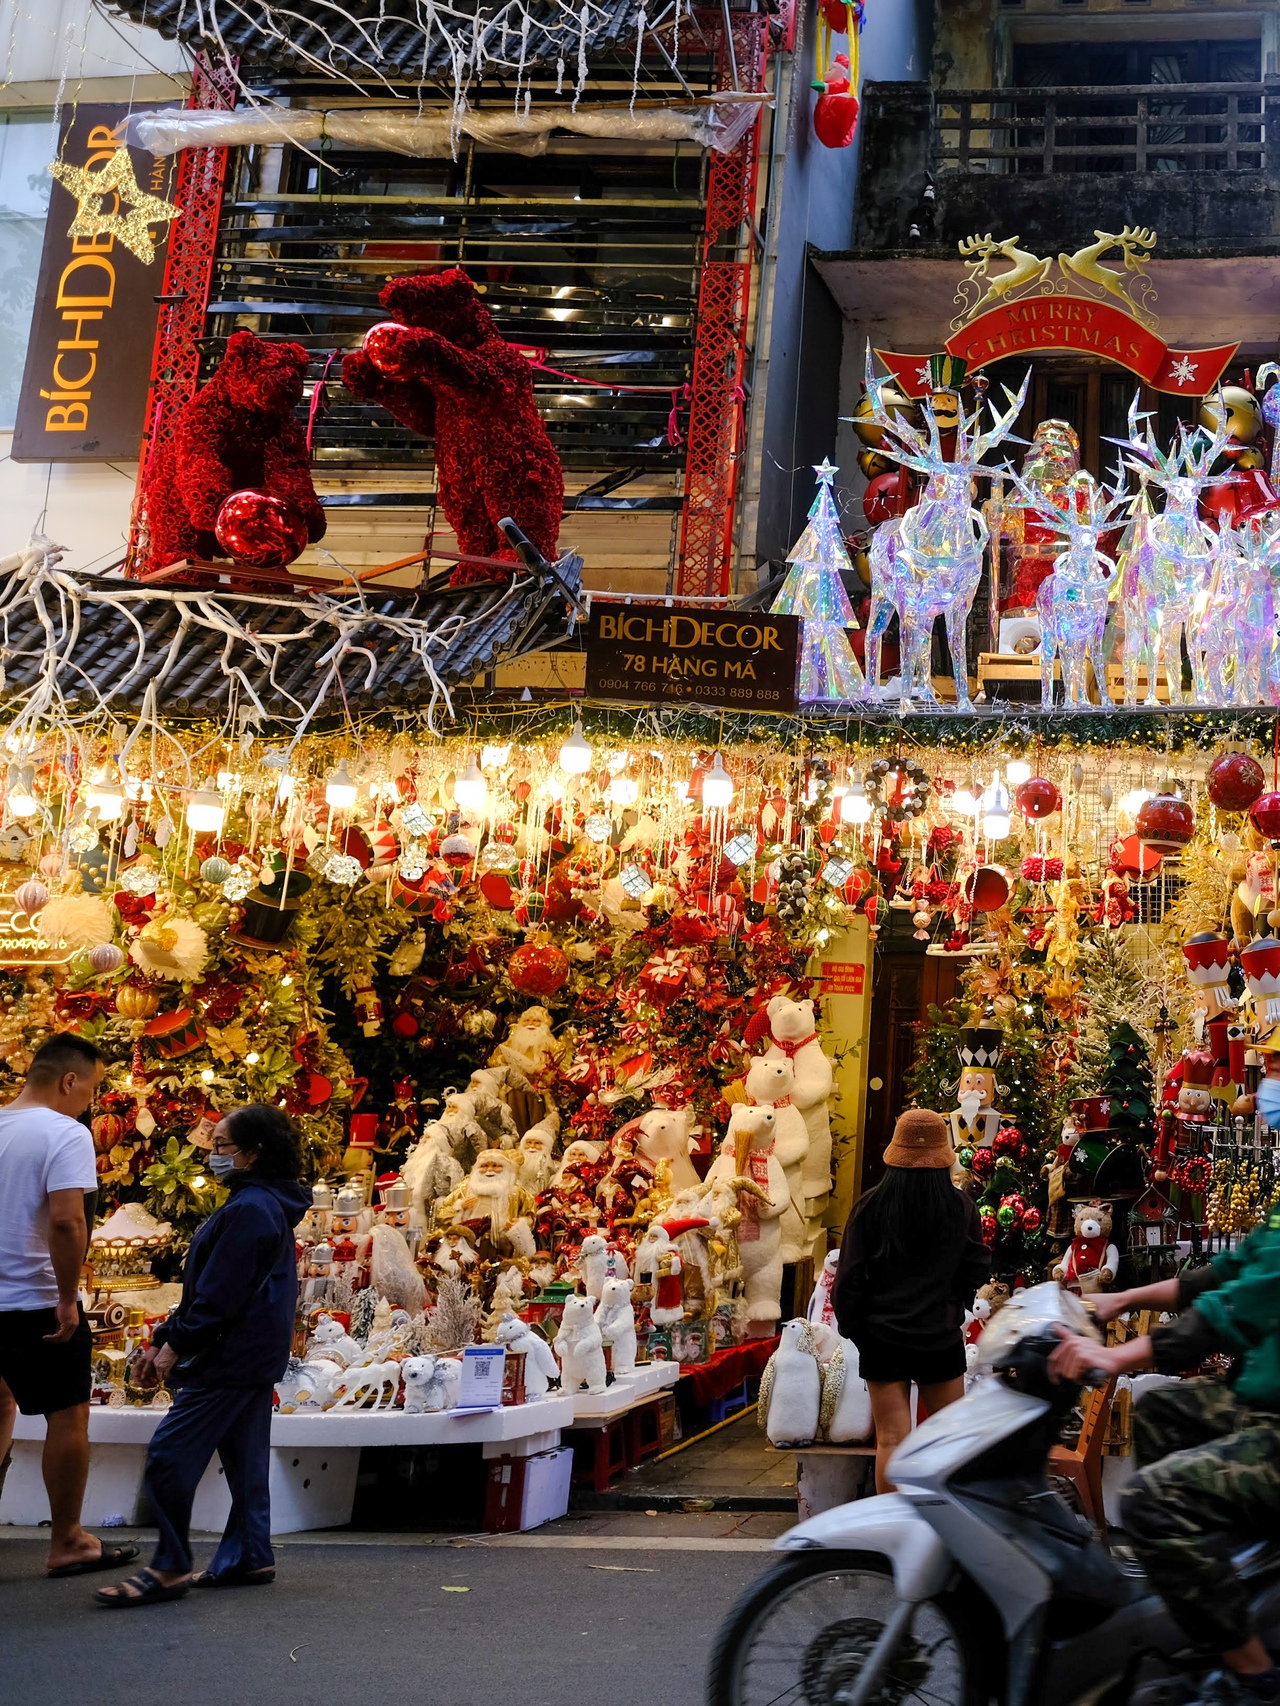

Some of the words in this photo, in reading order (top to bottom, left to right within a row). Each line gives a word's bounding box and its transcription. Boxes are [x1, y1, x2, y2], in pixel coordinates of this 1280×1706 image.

[1006, 303, 1100, 325] MERRY
[965, 325, 1143, 360] CHRISTMAS
[599, 612, 784, 651] BÍCHDECOR
[623, 654, 646, 673] 78
[725, 659, 757, 680] MÃ
[599, 679, 629, 691] 0904
[633, 681, 656, 692] 766
[695, 684, 725, 697] 0333
[729, 686, 753, 698] 889
[757, 688, 780, 701] 888
